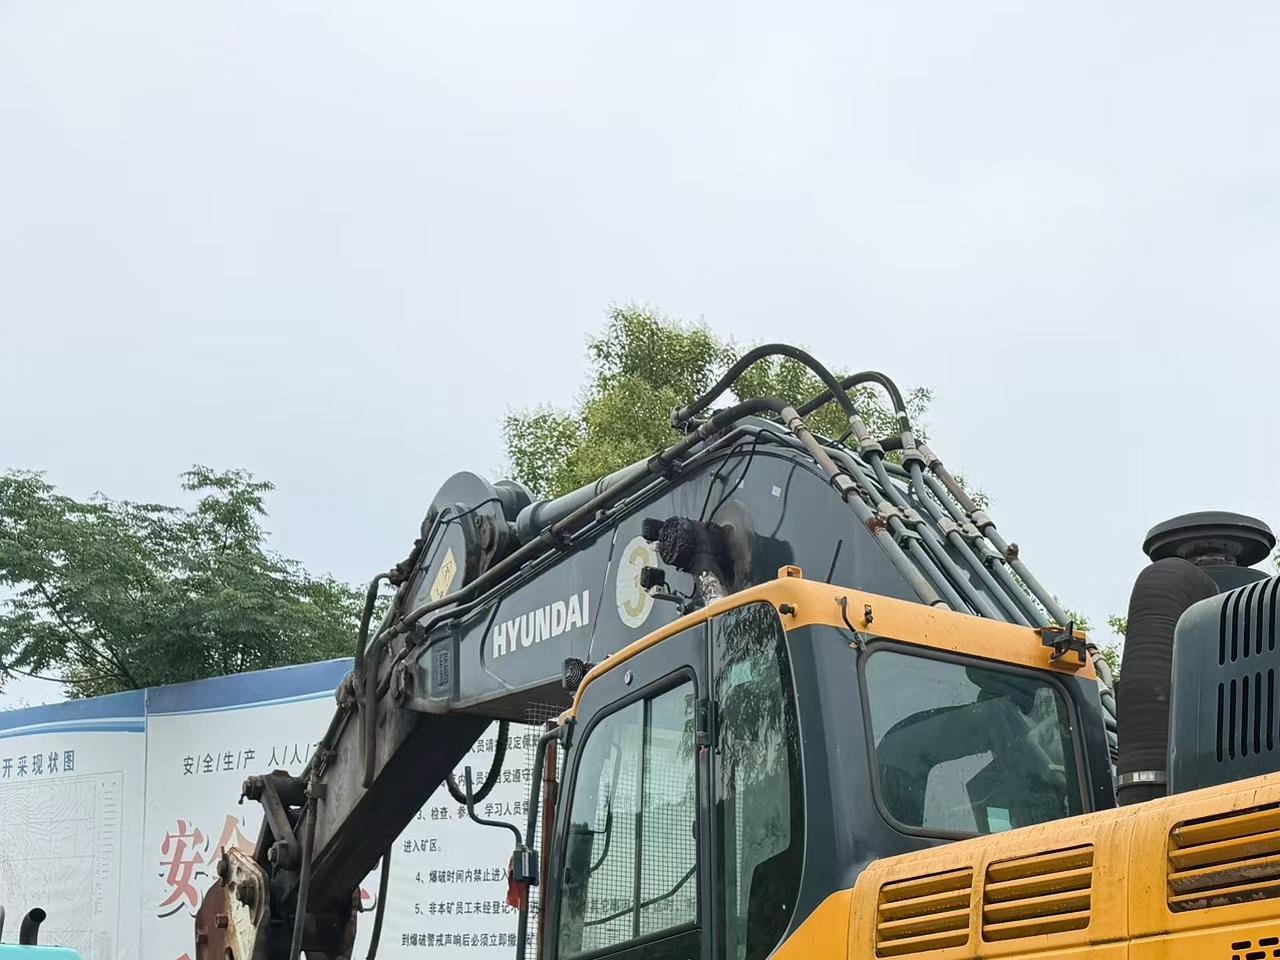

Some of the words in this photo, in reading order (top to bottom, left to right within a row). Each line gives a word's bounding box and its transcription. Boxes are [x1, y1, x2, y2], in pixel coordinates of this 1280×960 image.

[493, 590, 589, 658] HYUNDAI
[2, 749, 75, 778] 开采现状图
